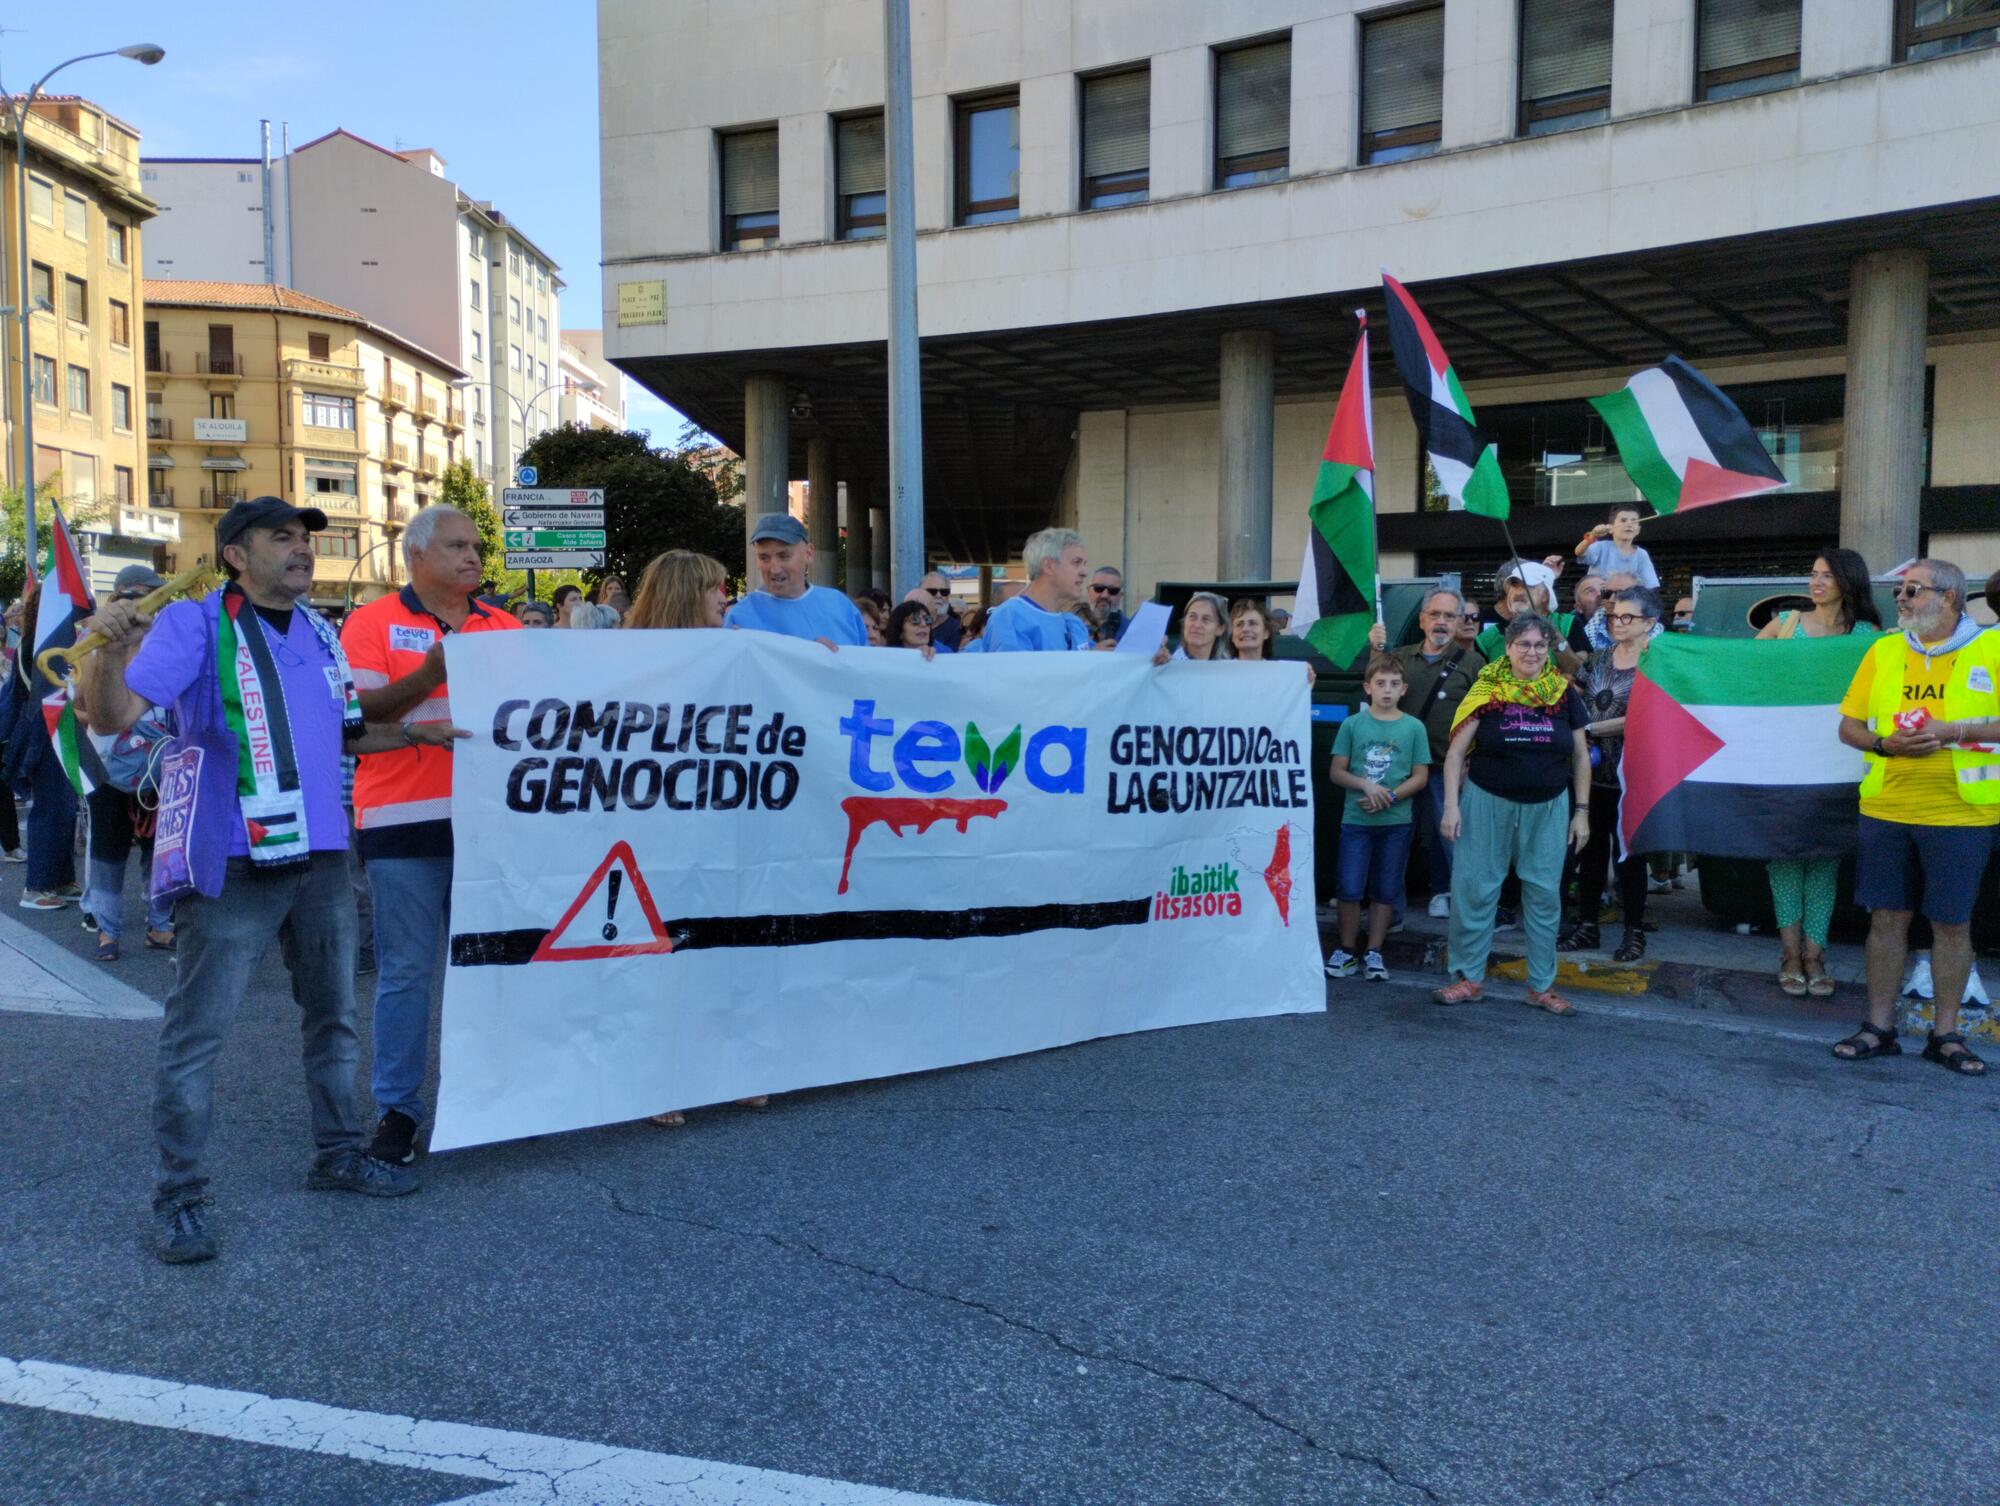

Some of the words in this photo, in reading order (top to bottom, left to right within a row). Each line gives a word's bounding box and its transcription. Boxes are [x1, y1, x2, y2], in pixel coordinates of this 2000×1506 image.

[208, 422, 243, 430] ALQUILA
[505, 493, 545, 501] FRANCIA
[558, 511, 569, 519] de
[570, 511, 602, 519] Navarra
[507, 556, 553, 565] ZARAGOZA
[238, 645, 274, 775] PALESTINE
[493, 697, 753, 755] COMPLICE
[756, 711, 807, 758] de
[840, 699, 1088, 794] teva
[506, 756, 799, 814] GENOCIDIO
[1107, 769, 1308, 814] LAGUNTZAILE
[1170, 862, 1239, 898] ibaitik
[1154, 892, 1243, 921] itsasora
